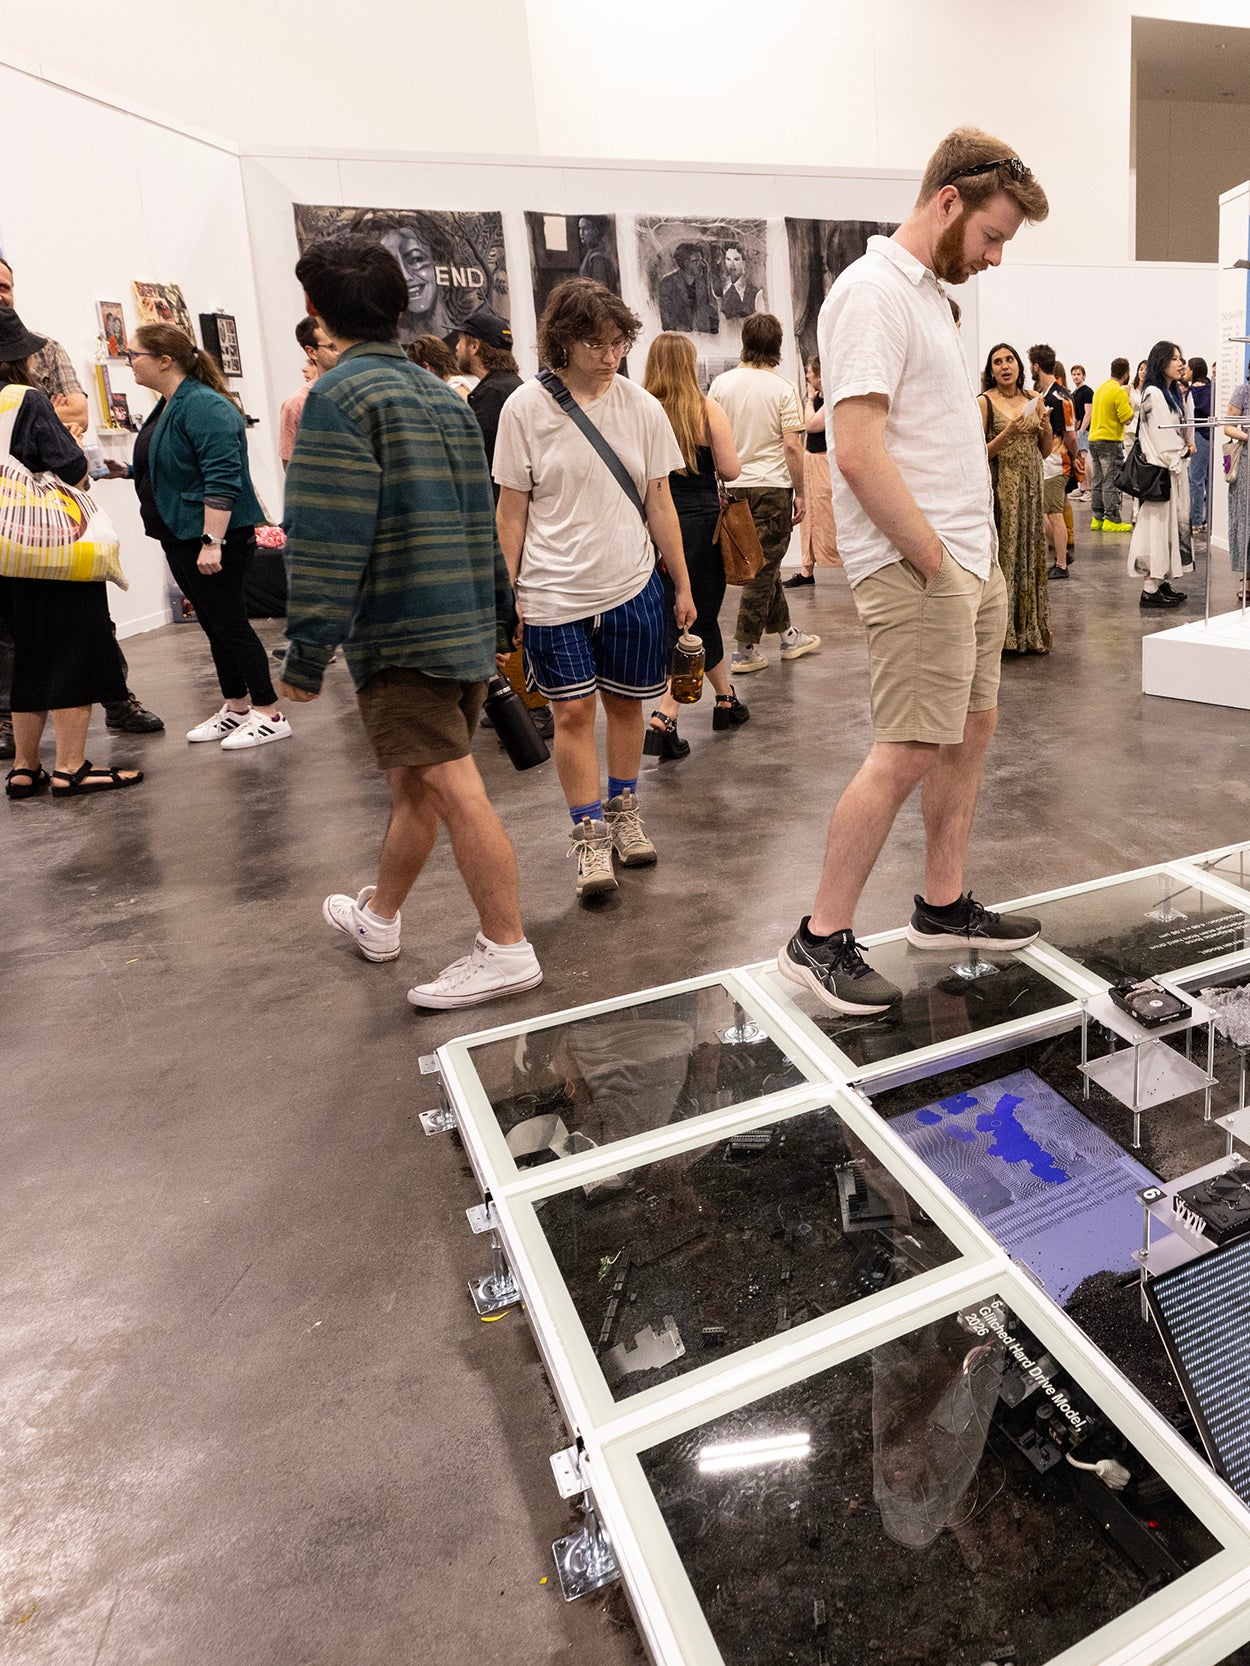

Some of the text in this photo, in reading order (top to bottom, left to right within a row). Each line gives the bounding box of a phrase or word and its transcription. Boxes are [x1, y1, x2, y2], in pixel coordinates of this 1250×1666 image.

[434, 265, 484, 288] END
[1143, 1188, 1161, 1199] 6
[991, 1300, 1003, 1309] 6
[964, 1313, 989, 1337] 2026
[979, 1306, 1087, 1432] Glitched Hard Drive Model,
